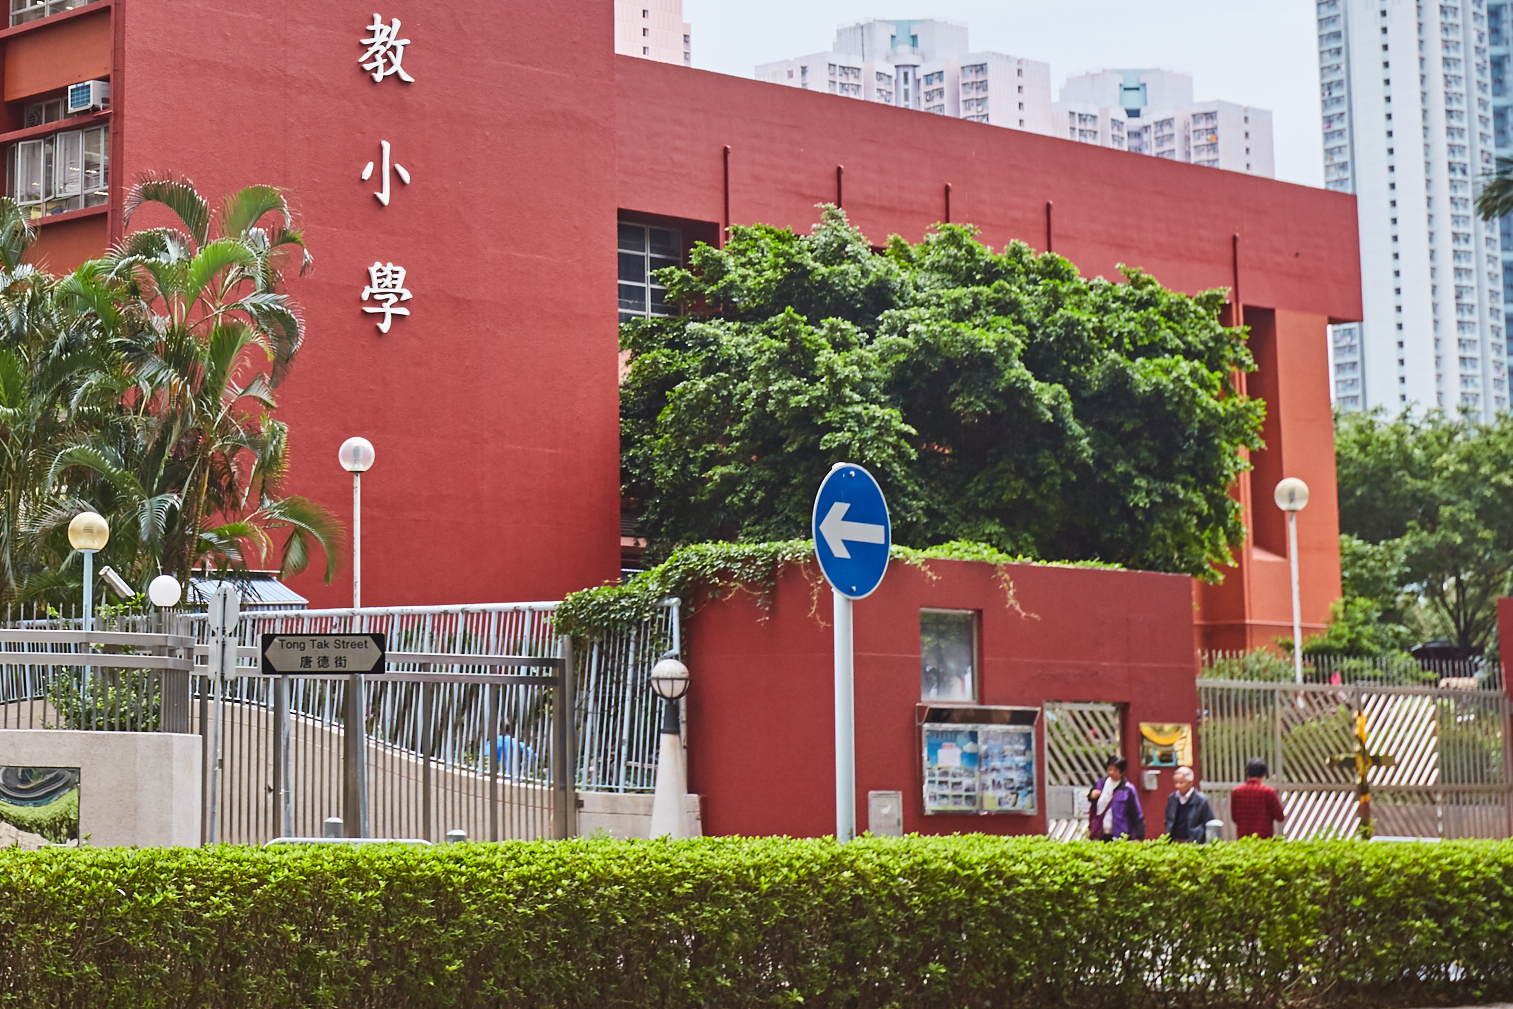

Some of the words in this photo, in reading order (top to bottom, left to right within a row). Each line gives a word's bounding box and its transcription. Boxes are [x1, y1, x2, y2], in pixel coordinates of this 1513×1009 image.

[278, 639, 306, 651] Tong
[309, 639, 330, 649] Tak
[333, 639, 369, 649] Street
[299, 656, 348, 669] 唐德街
